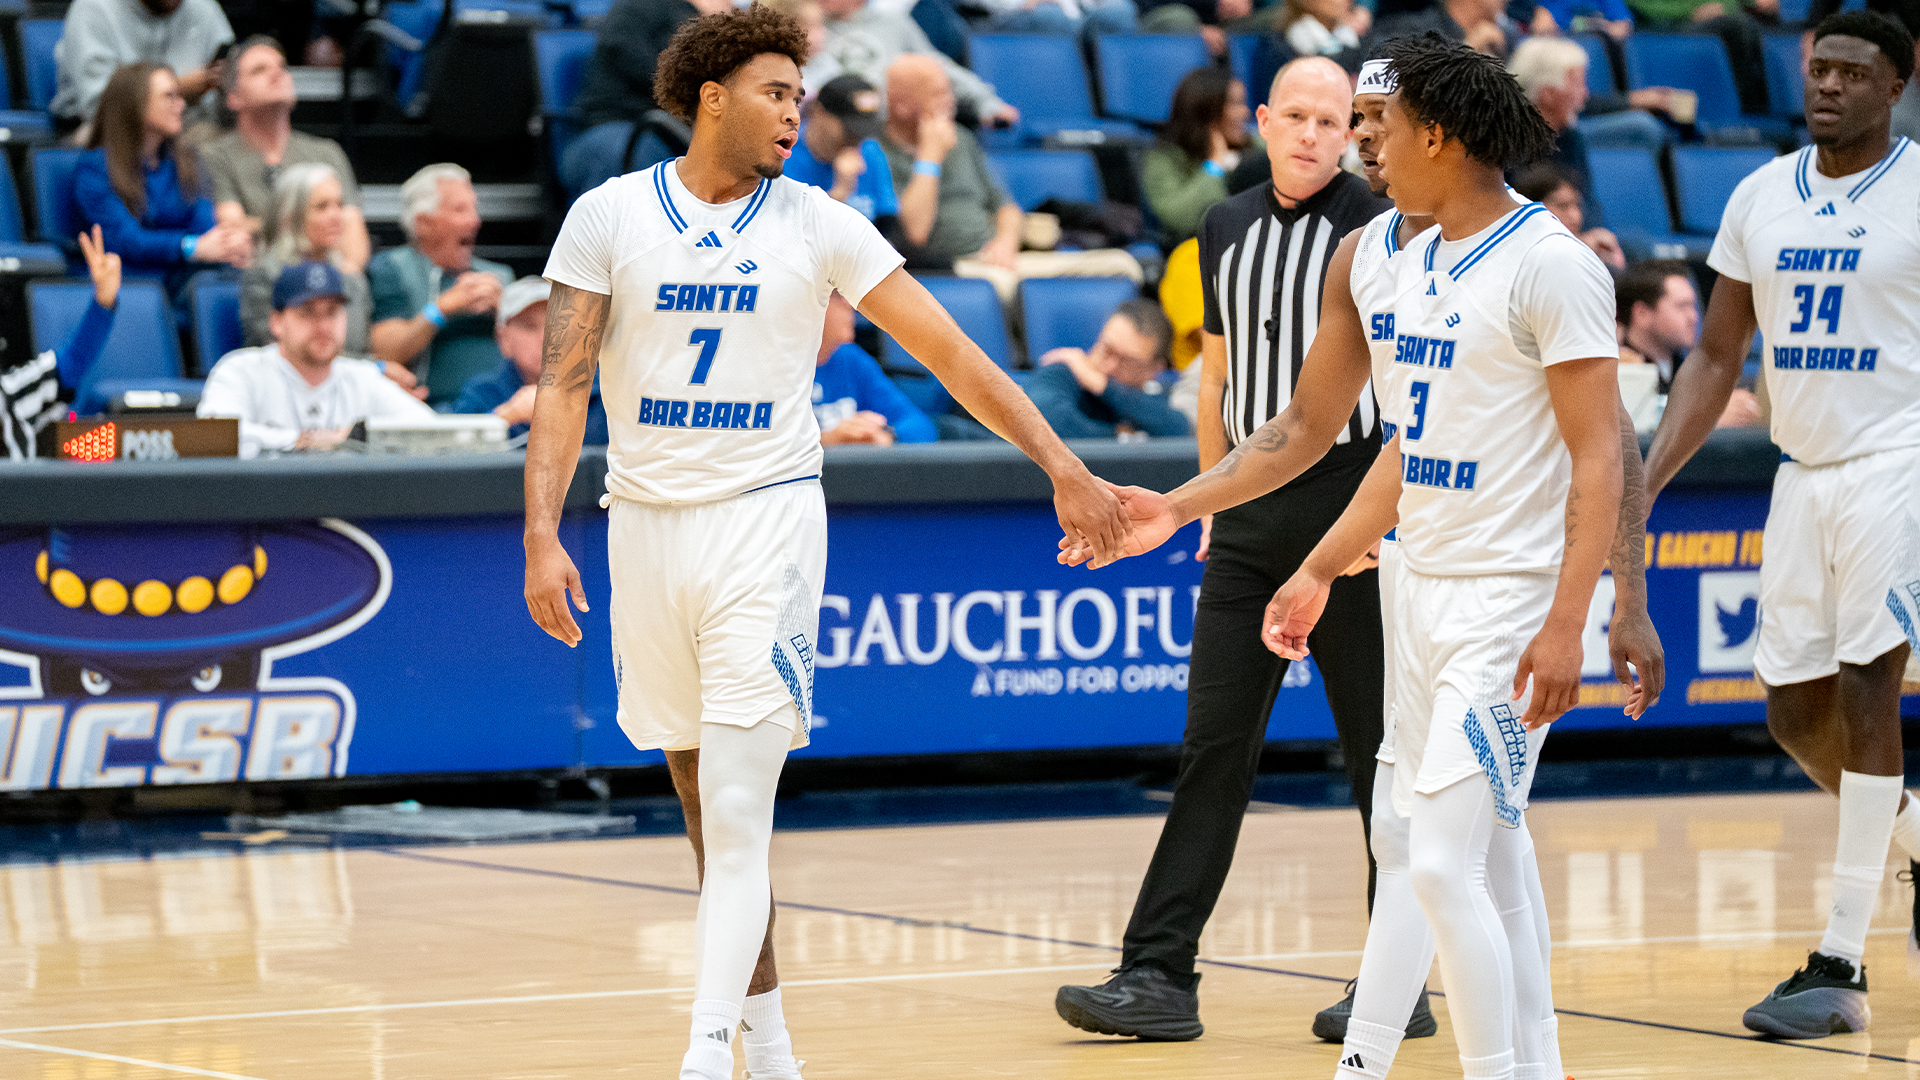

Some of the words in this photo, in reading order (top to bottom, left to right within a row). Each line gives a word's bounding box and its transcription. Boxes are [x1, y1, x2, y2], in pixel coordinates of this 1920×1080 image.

[1775, 247, 1863, 272] SANTA
[655, 283, 761, 313] SANTA
[1789, 283, 1844, 335] 34
[687, 327, 723, 386] 7
[1395, 333, 1457, 370] SANTA
[1773, 345, 1880, 373] BARBARA
[637, 395, 775, 431] BARBARA
[1405, 380, 1431, 442] 3
[1401, 452, 1480, 491] BARA
[994, 667, 1064, 697] FUND
[1066, 664, 1119, 694] FOR
[0, 699, 340, 792] UCSB
